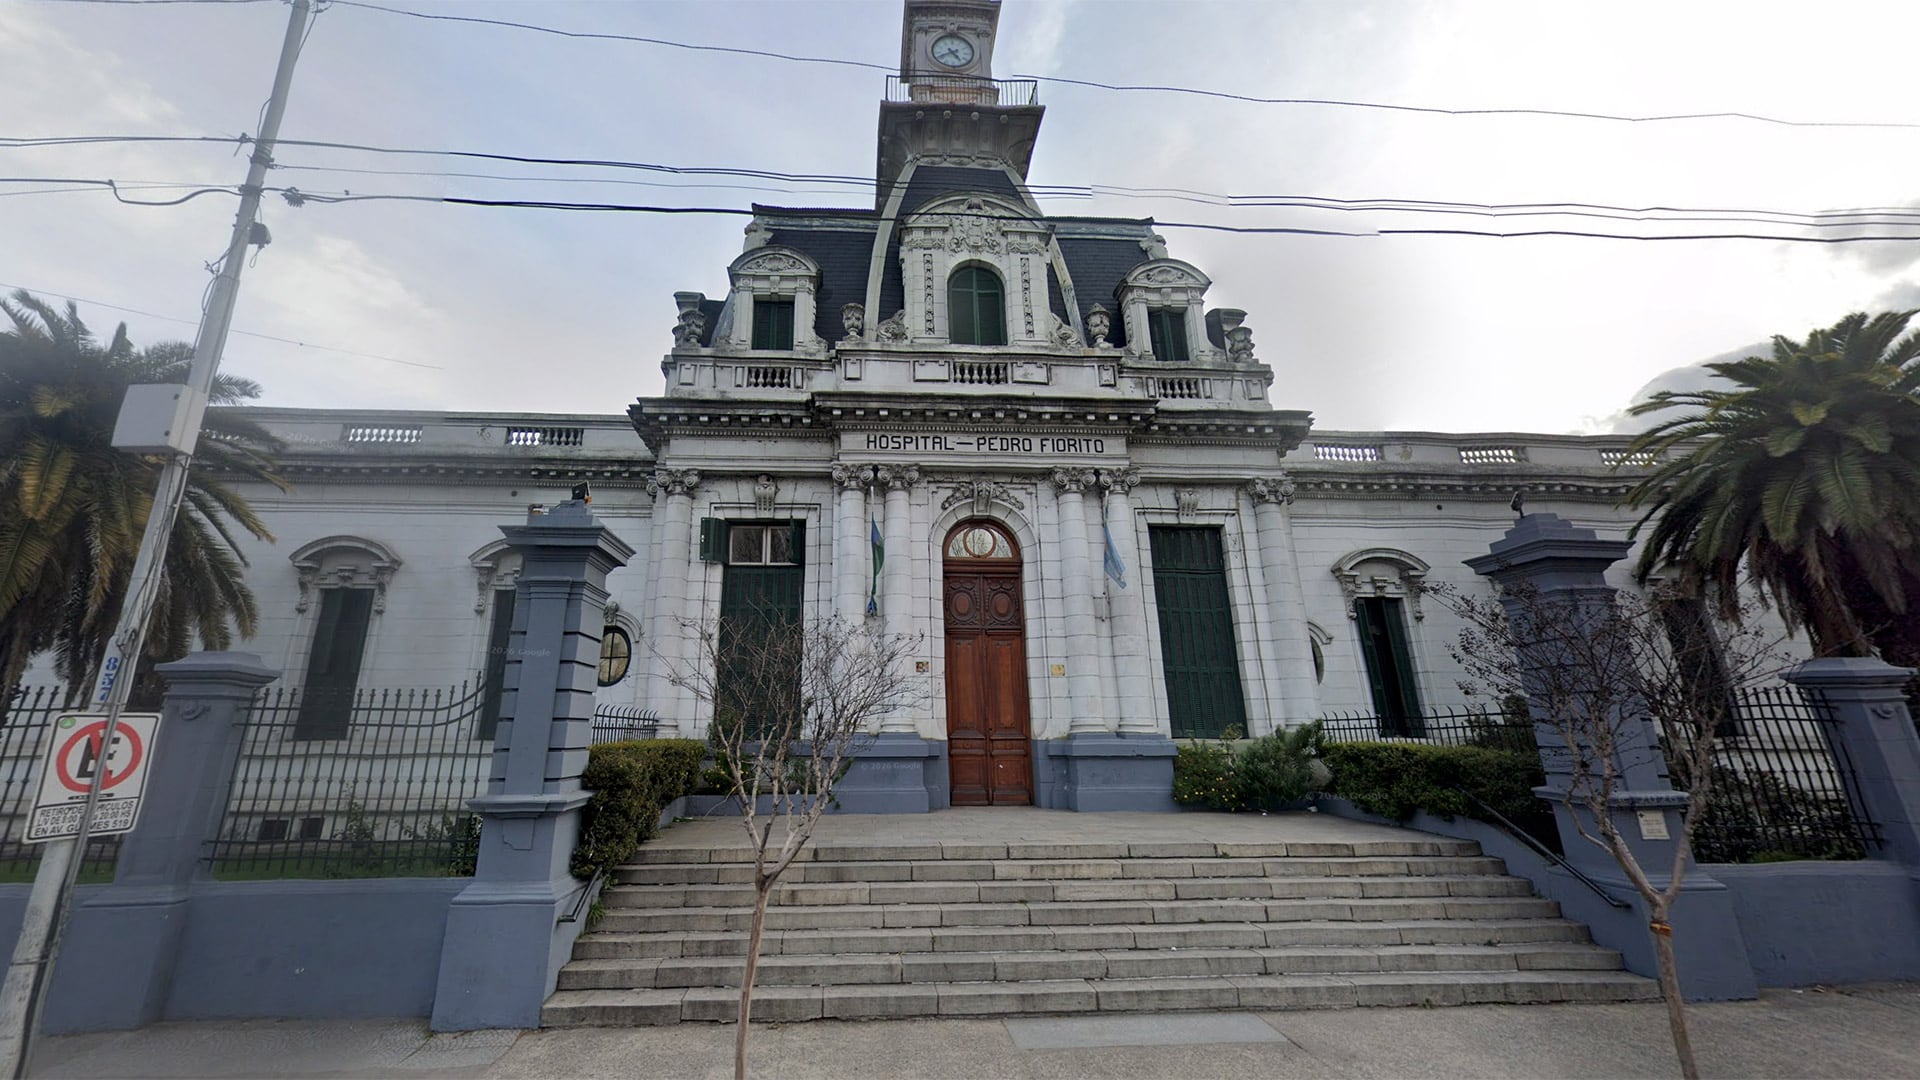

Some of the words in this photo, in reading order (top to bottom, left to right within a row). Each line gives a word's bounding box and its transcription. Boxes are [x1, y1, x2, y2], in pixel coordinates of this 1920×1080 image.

[866, 434, 955, 451] HOSPITAL
[976, 436, 1032, 452] PEDRO
[1039, 437, 1104, 453] FIORITO
[40, 806, 71, 818] RETIRO
[71, 805, 85, 815] DE
[93, 801, 134, 811] HICULOS
[34, 826, 49, 837] EN
[112, 819, 129, 829] 519
